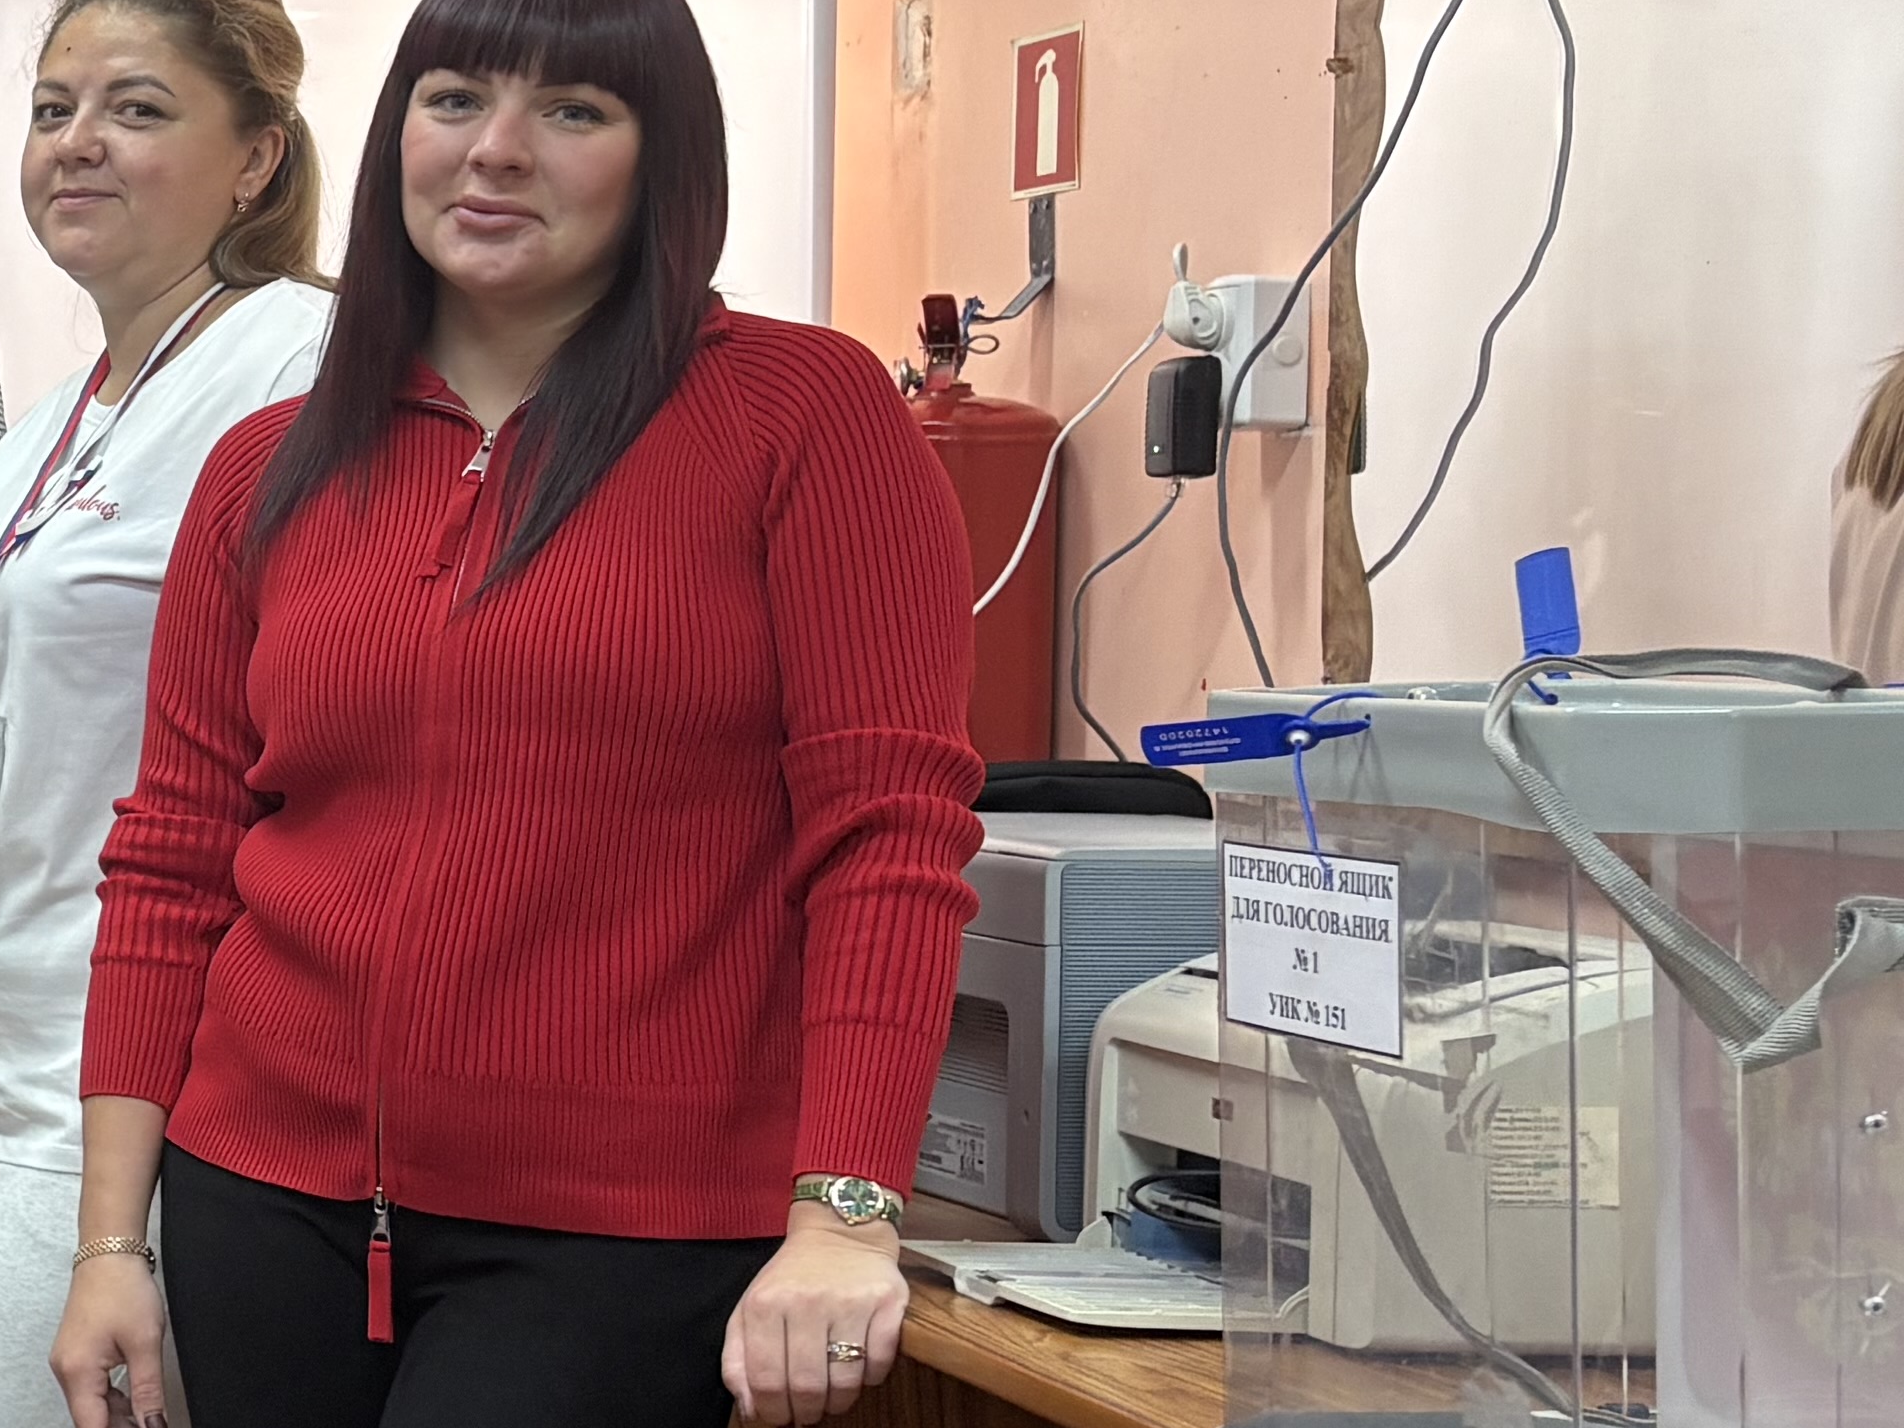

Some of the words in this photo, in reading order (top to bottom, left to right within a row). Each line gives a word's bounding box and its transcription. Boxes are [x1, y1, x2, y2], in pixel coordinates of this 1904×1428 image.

[65, 484, 121, 522] ulous.
[1229, 855, 1334, 892] ПЕРЕНОСНОЙ
[1337, 870, 1394, 901] ЯЩИК
[1231, 896, 1262, 923] ДЛЯ
[1264, 901, 1392, 943] ГОЛОСОВАНИЯ
[1292, 947, 1308, 972] №
[1311, 952, 1319, 974] 1
[1269, 992, 1301, 1021] УИК
[1304, 1000, 1320, 1025] №
[1324, 1004, 1347, 1031] 151
